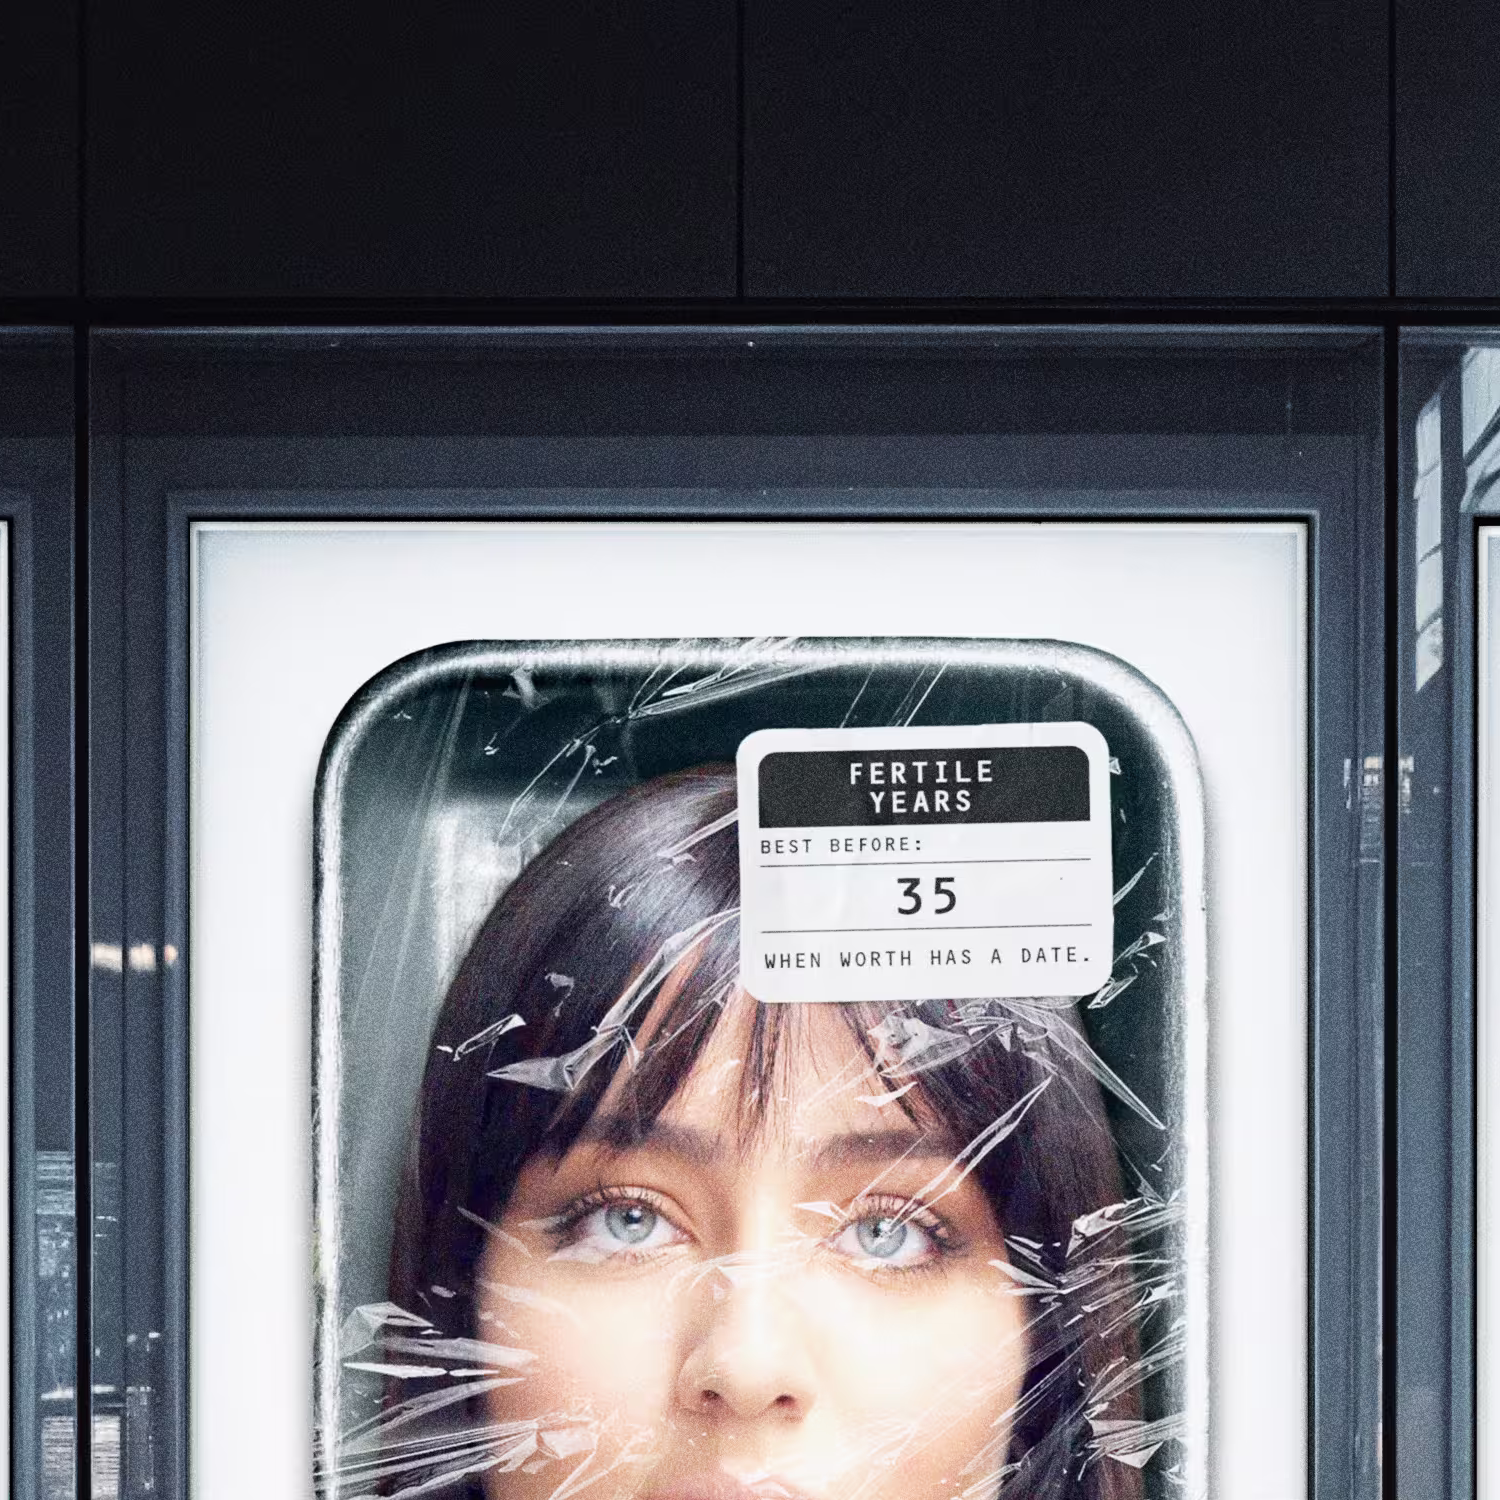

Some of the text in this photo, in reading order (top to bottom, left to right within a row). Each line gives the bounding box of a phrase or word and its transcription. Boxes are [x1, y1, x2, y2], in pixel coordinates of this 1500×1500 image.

[851, 760, 992, 784] FERTILE
[870, 790, 970, 813] YEARS
[761, 837, 920, 854] BEST BEFORE:
[898, 877, 956, 915] 35
[765, 947, 1088, 968] WHEN WORTH HAS A DATE.
